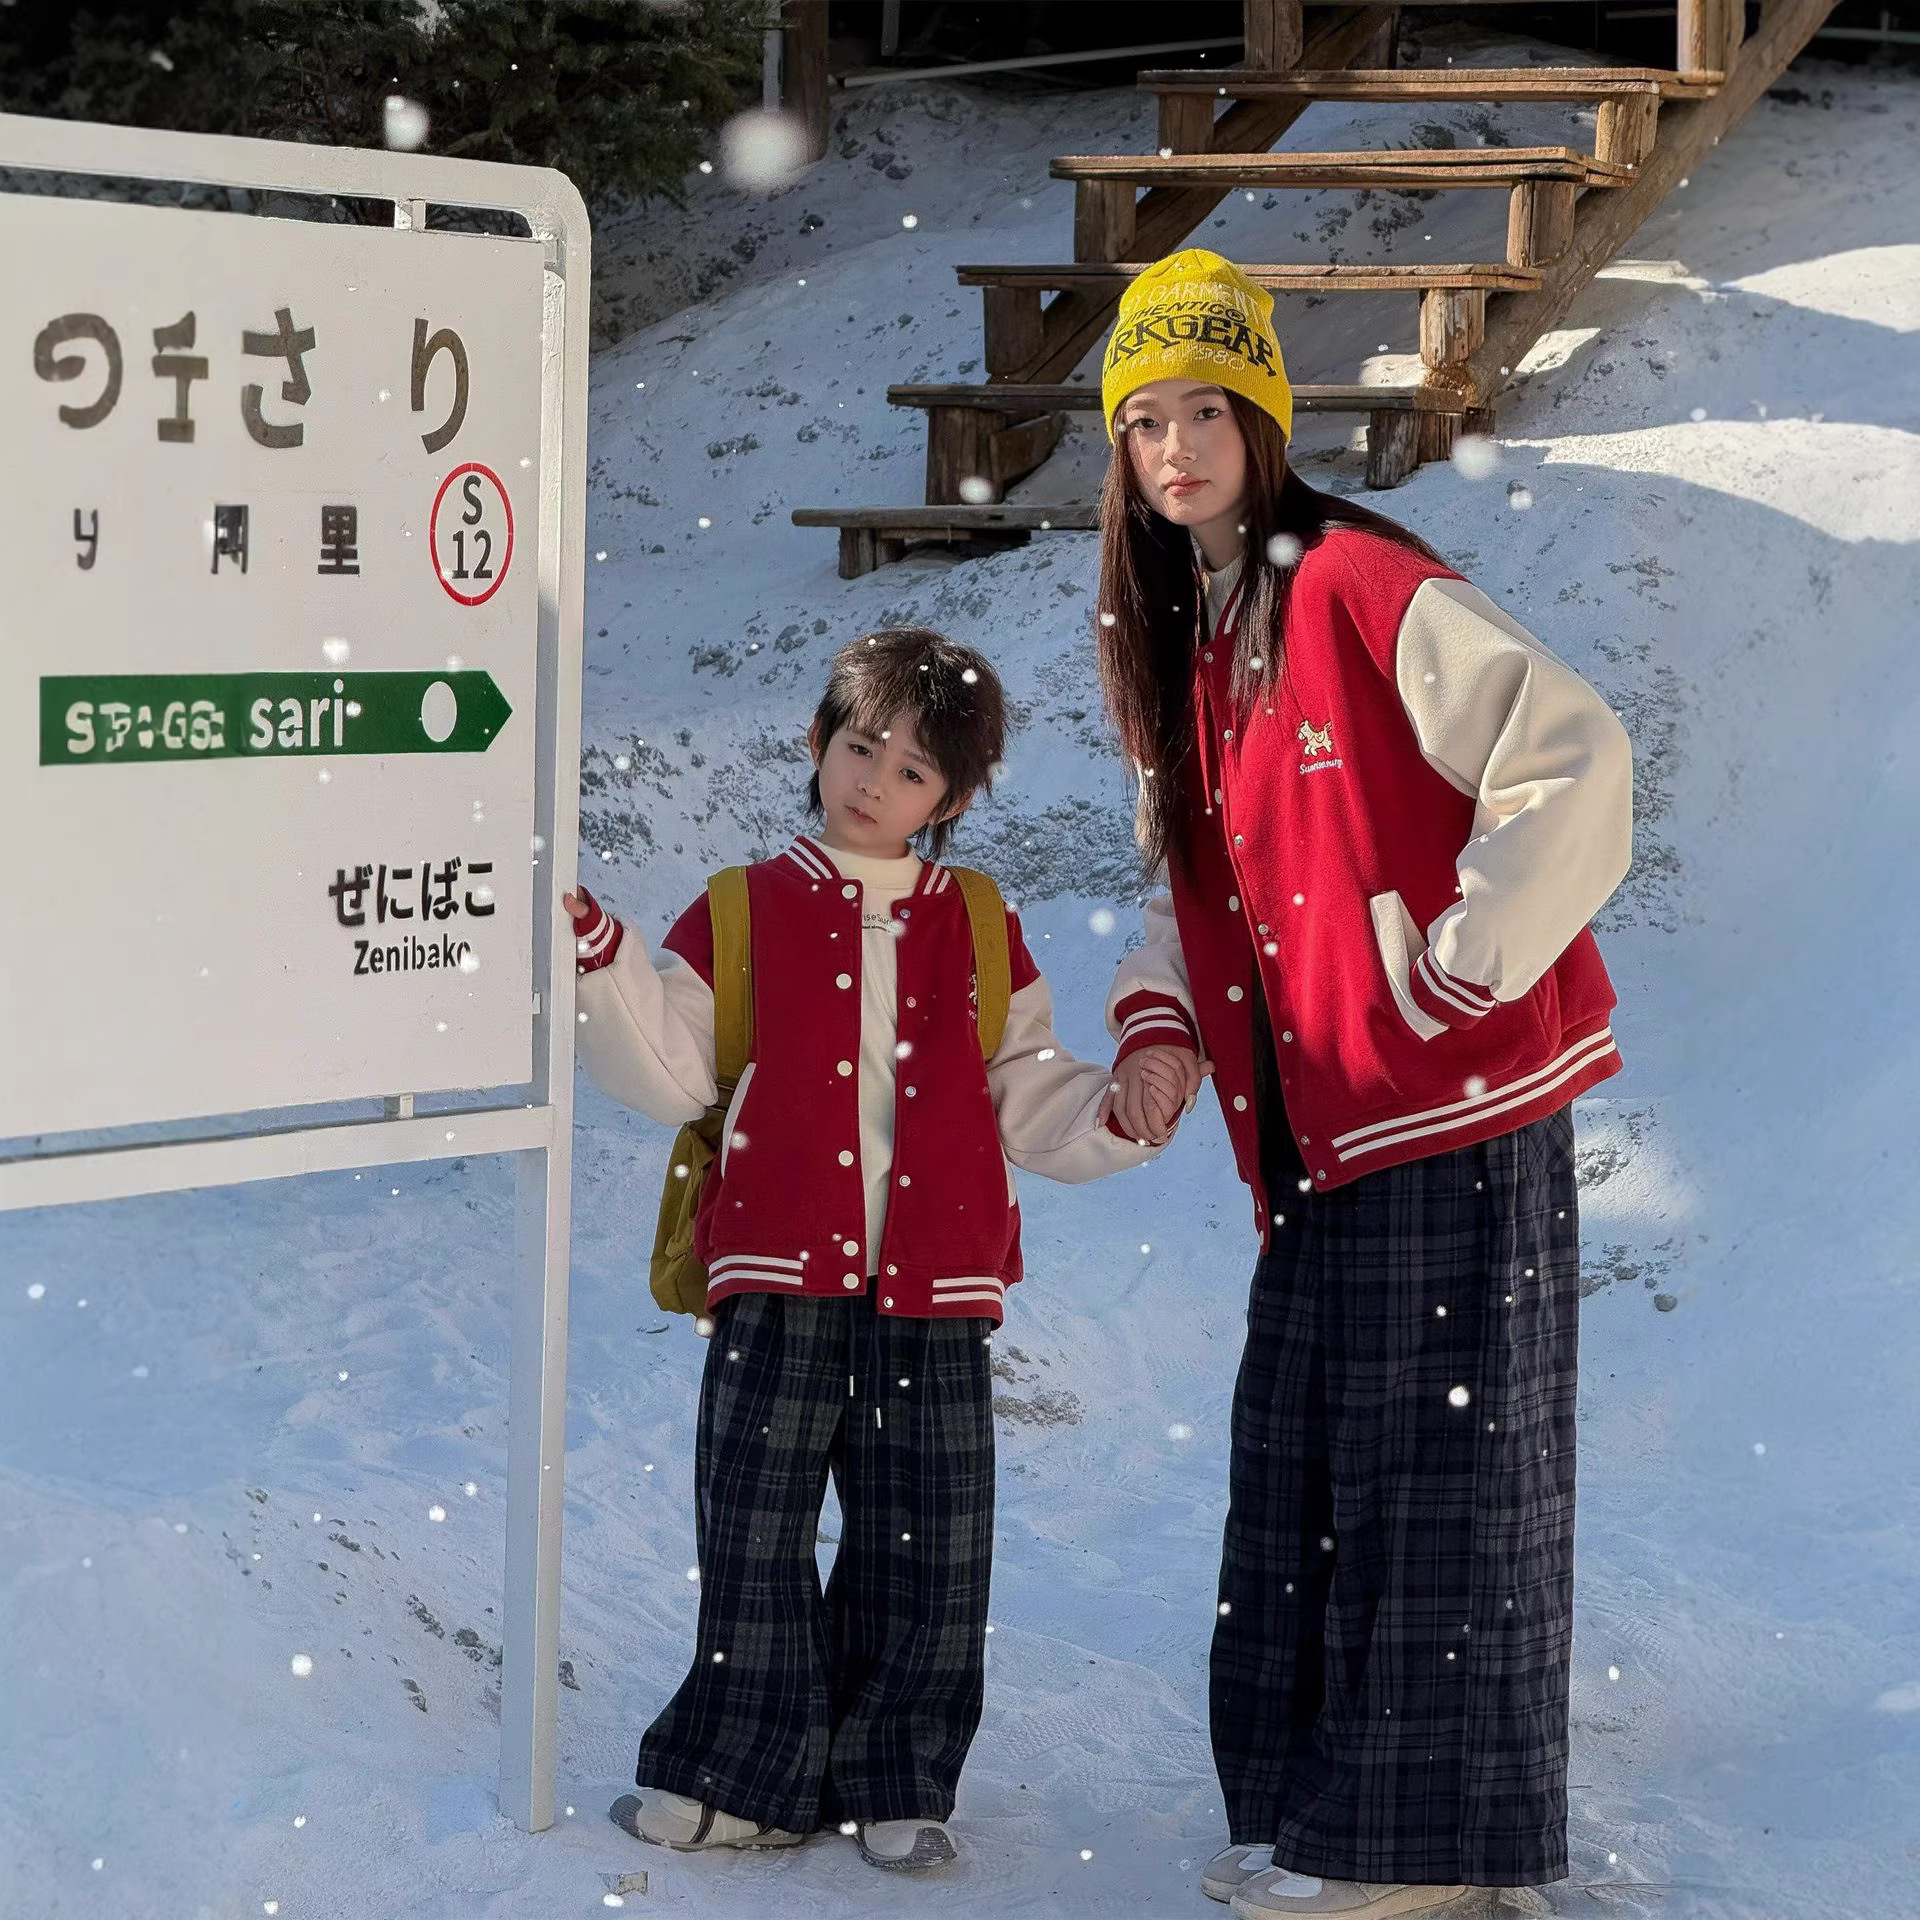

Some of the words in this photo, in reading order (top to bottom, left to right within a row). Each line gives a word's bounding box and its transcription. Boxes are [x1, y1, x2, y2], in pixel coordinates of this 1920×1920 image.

[462, 474, 483, 526] S
[452, 529, 493, 580] 12
[250, 678, 344, 748] sari
[328, 856, 496, 927] ぜにばこ
[353, 933, 473, 976] Zenibako
